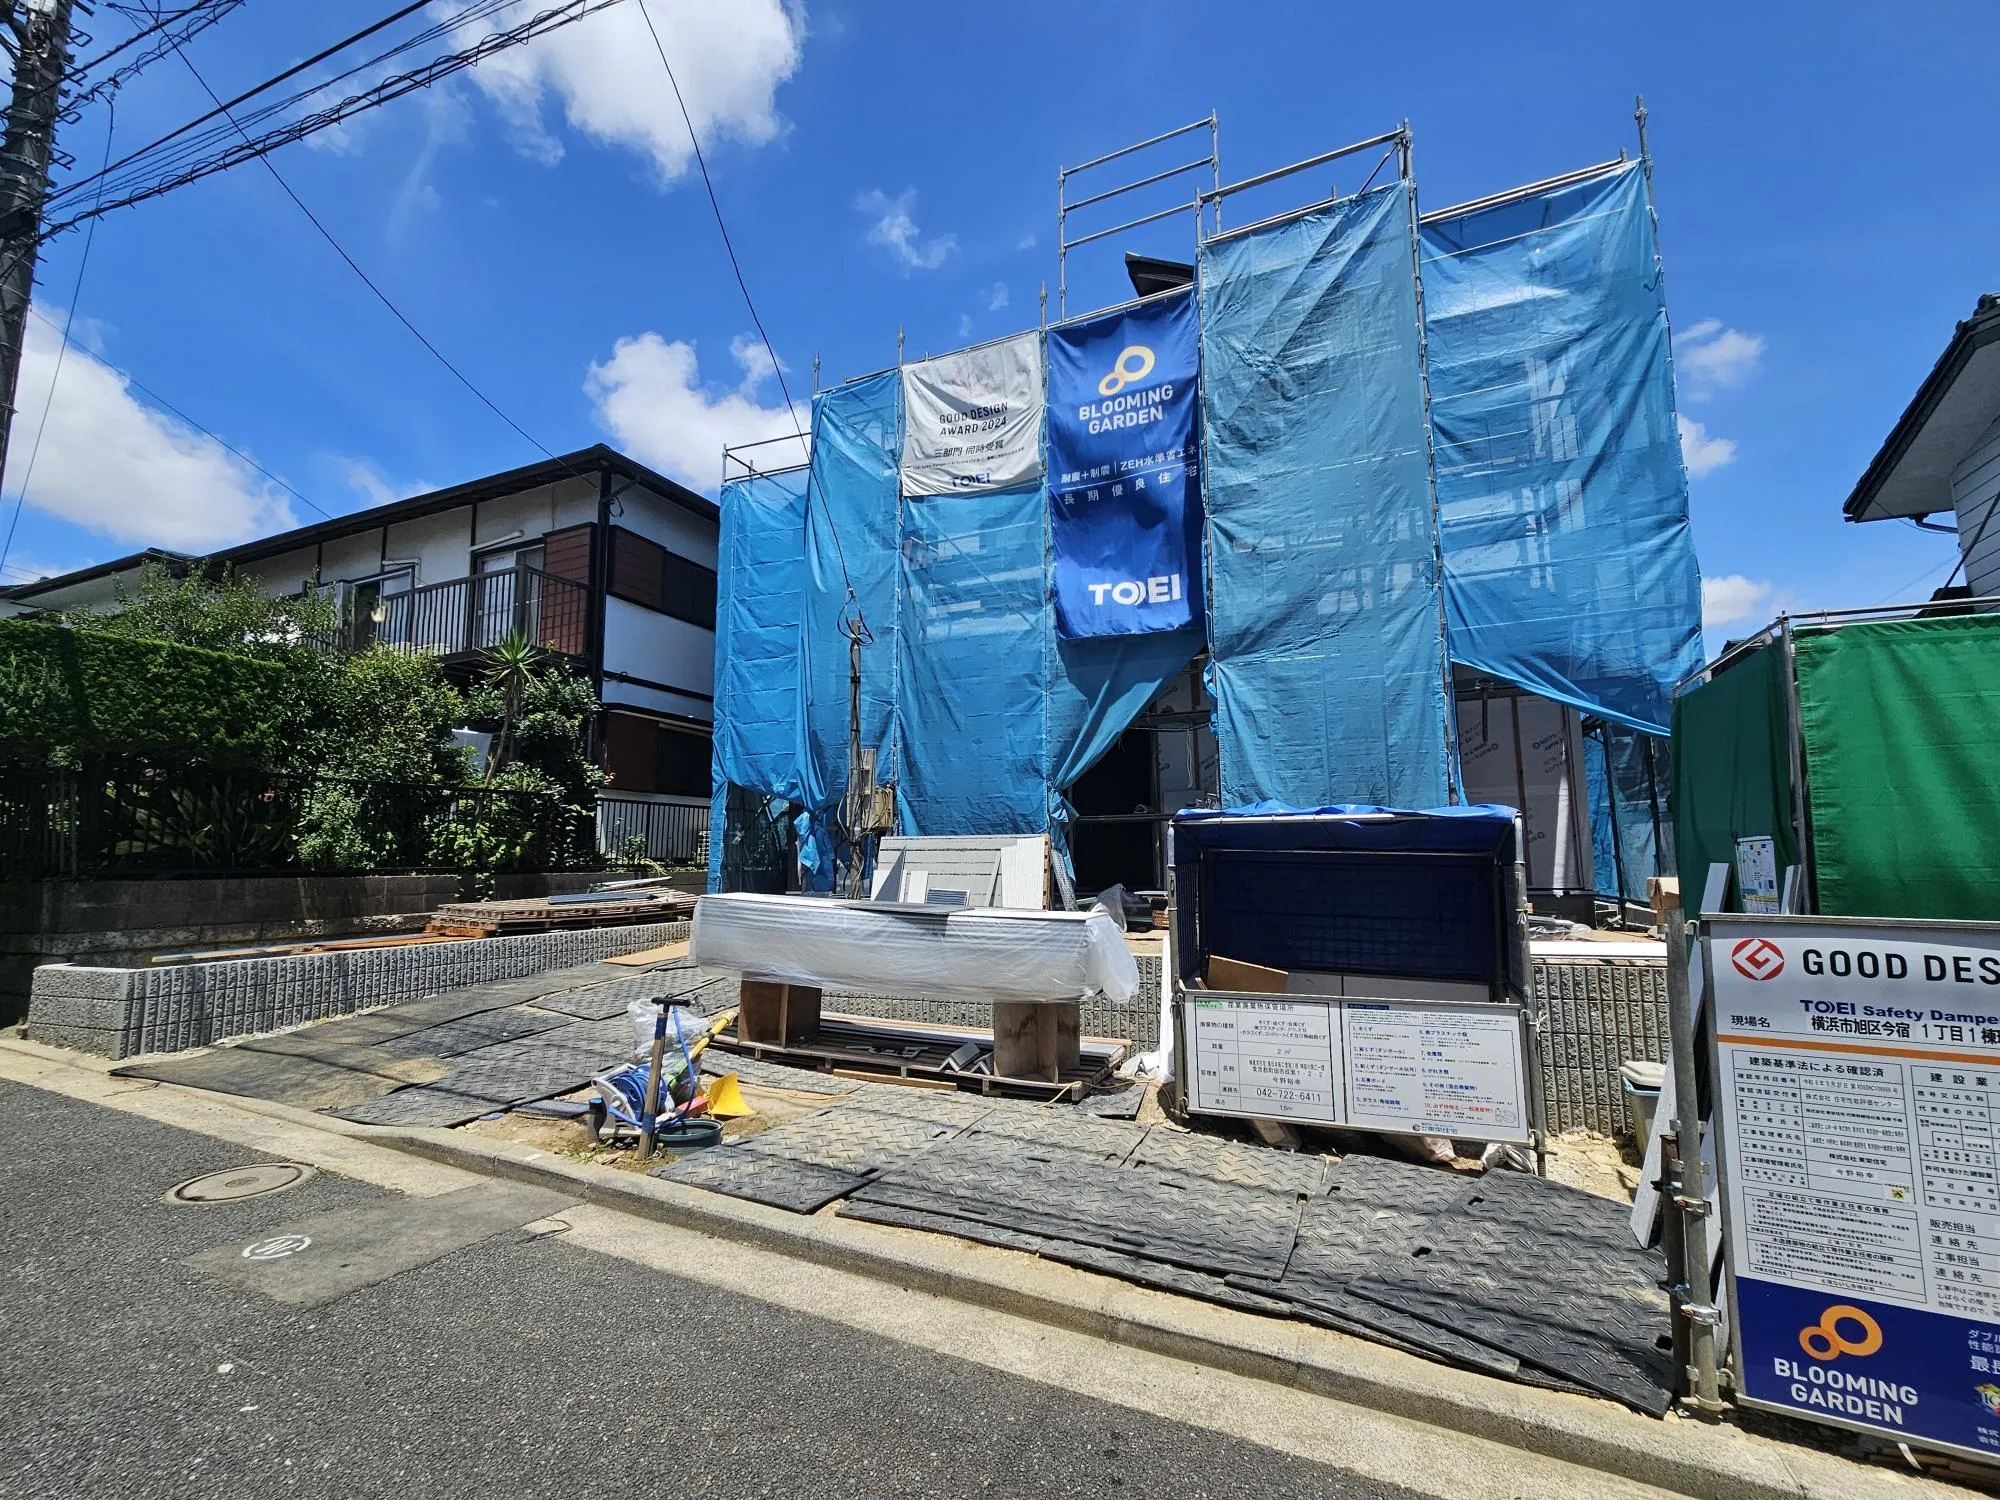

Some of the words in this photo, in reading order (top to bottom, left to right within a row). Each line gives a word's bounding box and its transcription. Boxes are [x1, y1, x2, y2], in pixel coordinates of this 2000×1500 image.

[939, 412, 968, 424] GOOD
[970, 401, 1008, 420] DESIGN
[1079, 384, 1174, 421] BLOOMING
[939, 424, 978, 437] AWARD
[981, 416, 1008, 432] 2024
[1088, 405, 1163, 435] GARDEN
[1064, 465, 1198, 505] 長期優良住宅
[1087, 573, 1181, 606] TOEI
[1802, 949, 1909, 980] GOOD
[1924, 954, 2000, 985] DES
[1731, 1015, 1771, 1029] 現場名
[1800, 999, 1856, 1016] TOEI
[1863, 1005, 1924, 1023] Safety
[1811, 1014, 1910, 1039] 横浜市旭区今宿
[1921, 1023, 2000, 1045] 1丁目1棟
[1200, 1069, 1217, 1077] 管理者
[1749, 1056, 1885, 1078] 建築基準法による確認済
[1256, 1087, 1321, 1102] 042-722-6411
[1929, 1218, 1976, 1234] 販売担当
[1931, 1234, 1979, 1250] 連絡先
[1933, 1251, 1981, 1267] 工事担当
[1935, 1266, 1983, 1283] 連絡先
[1774, 1357, 1919, 1406] BLOOMING
[1790, 1383, 1904, 1425] GARDEN
